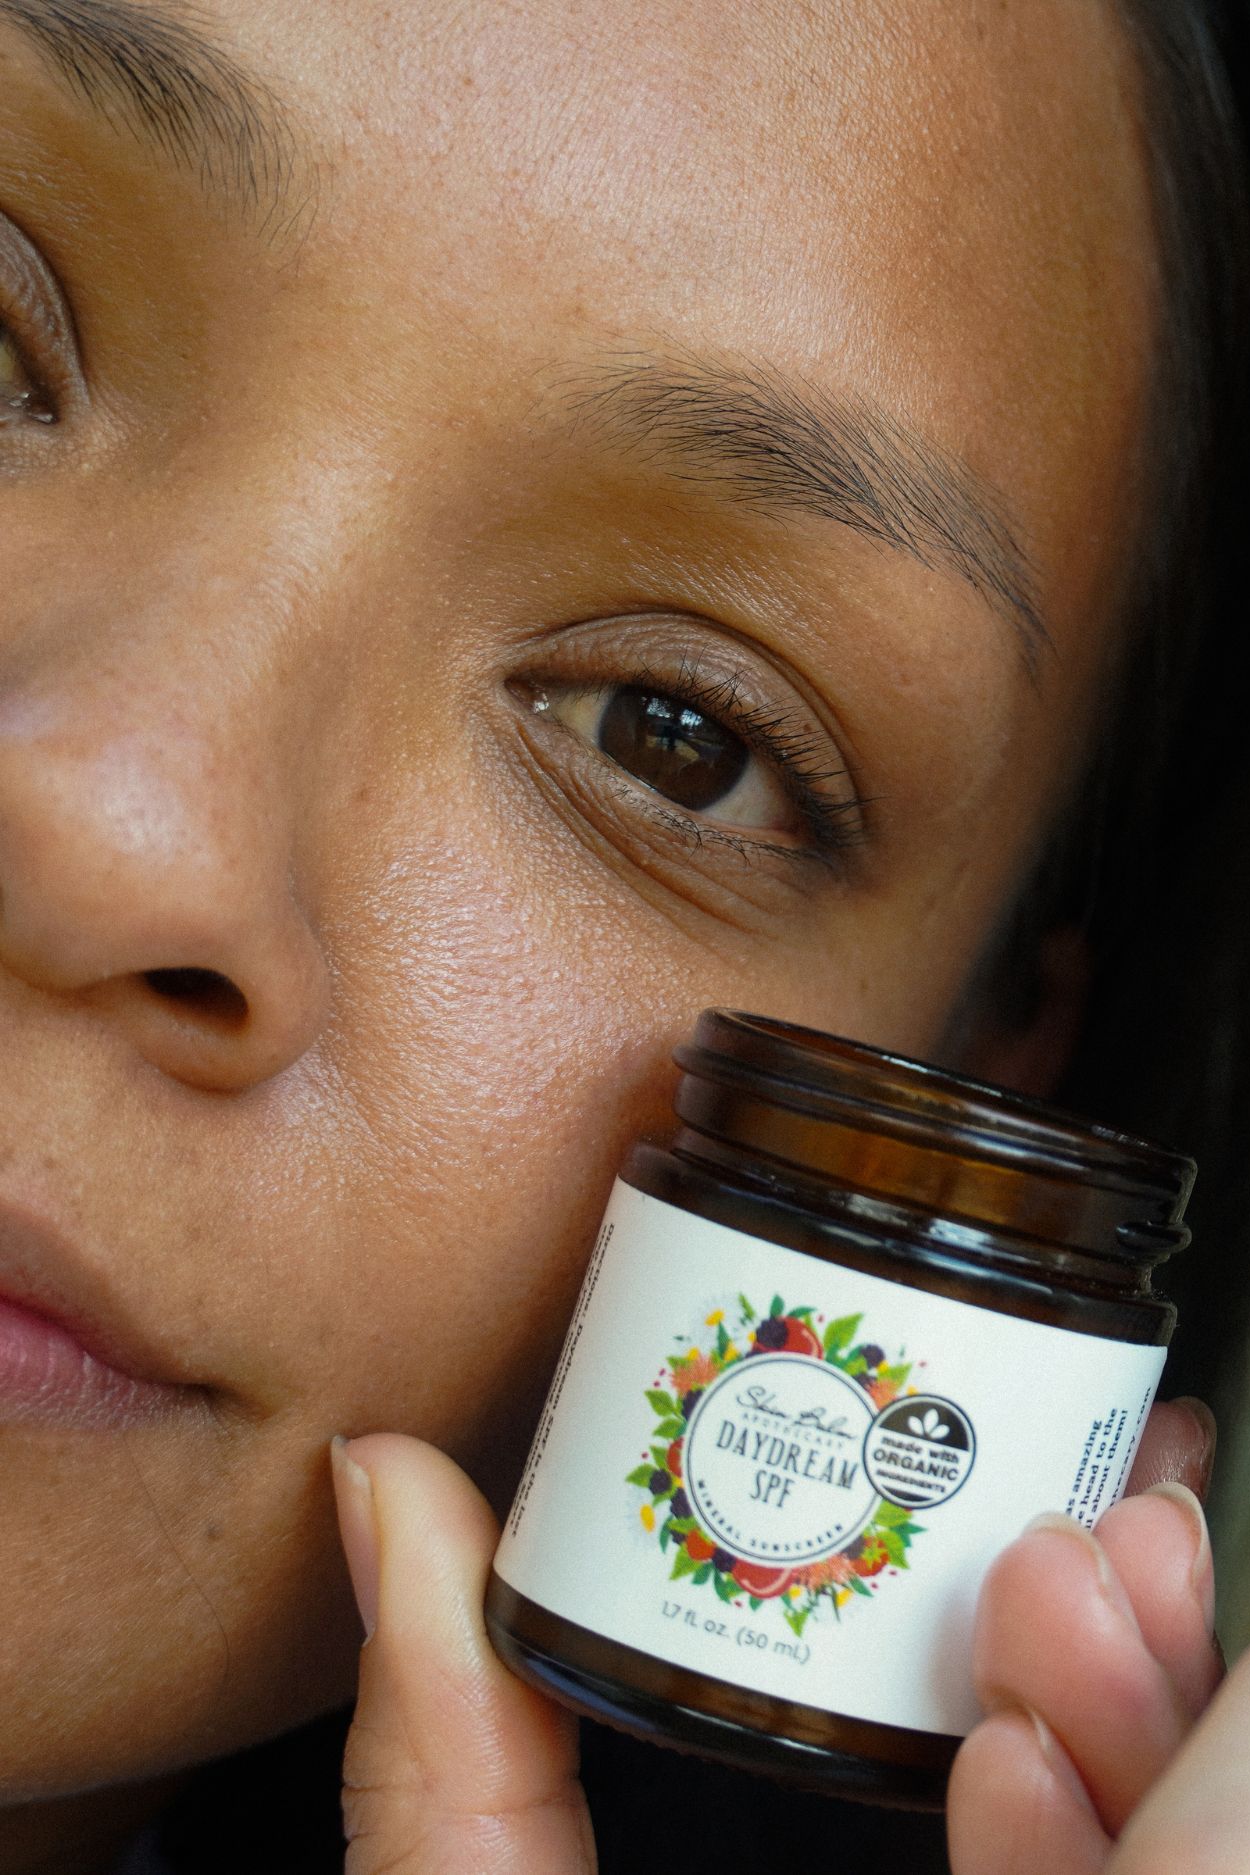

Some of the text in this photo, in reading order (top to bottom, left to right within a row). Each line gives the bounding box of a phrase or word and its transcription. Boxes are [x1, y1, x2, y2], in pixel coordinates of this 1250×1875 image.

[581, 1223, 615, 1316] Directions:
[552, 1323, 583, 1409] Daydream
[539, 1415, 555, 1450] SPF
[881, 1436, 959, 1464] made with
[533, 1453, 542, 1467] is
[717, 1420, 859, 1489] DAYDREAM
[873, 1448, 959, 1482] ORGANIC
[1073, 1420, 1102, 1492] amazing
[1080, 1464, 1099, 1505] head
[1094, 1442, 1106, 1459] to
[1102, 1408, 1117, 1436] the
[1091, 1465, 1110, 1513] about
[1106, 1409, 1128, 1459] them!
[523, 1473, 536, 1500] the
[749, 1470, 795, 1508] SPF
[510, 1505, 526, 1538] last
[698, 1480, 844, 1552] MINERAL SUNSCREEN
[736, 1626, 768, 1649] (50
